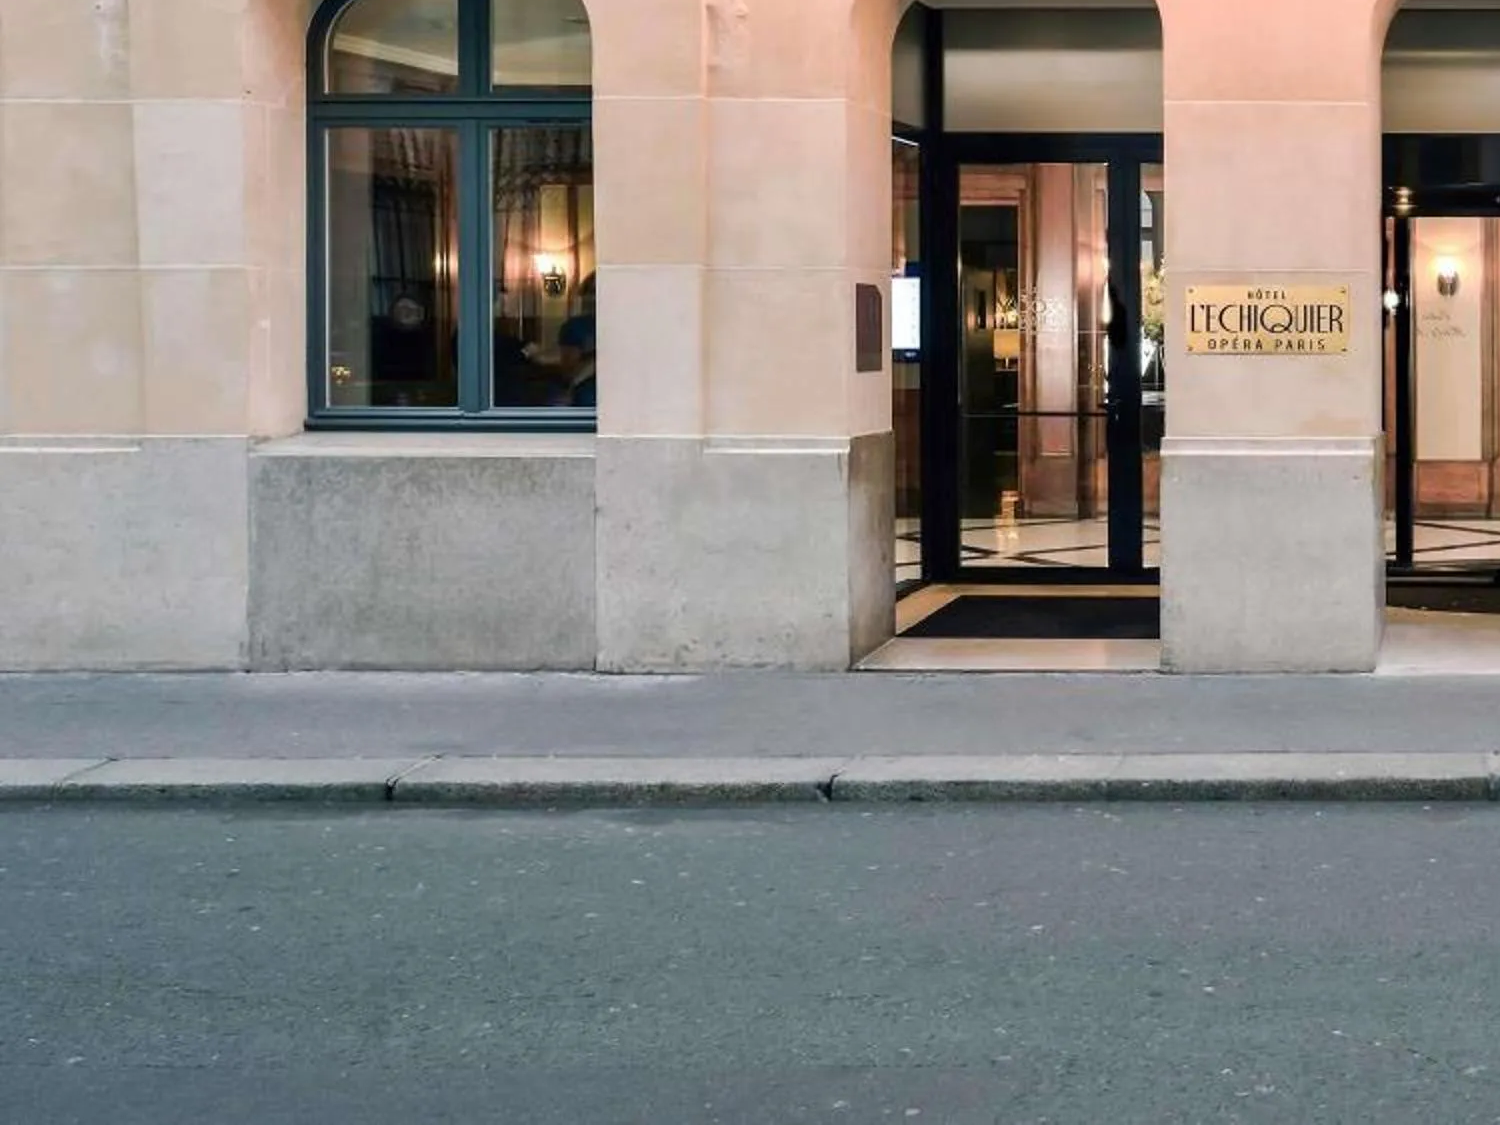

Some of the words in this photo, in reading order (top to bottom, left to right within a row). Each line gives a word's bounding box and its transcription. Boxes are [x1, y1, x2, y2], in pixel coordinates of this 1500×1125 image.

[1247, 288, 1286, 300] HÔTEL
[1190, 304, 1344, 334] L'ECHIQUIER
[1207, 336, 1264, 351] OPÉRA
[1274, 338, 1326, 351] PARIS
